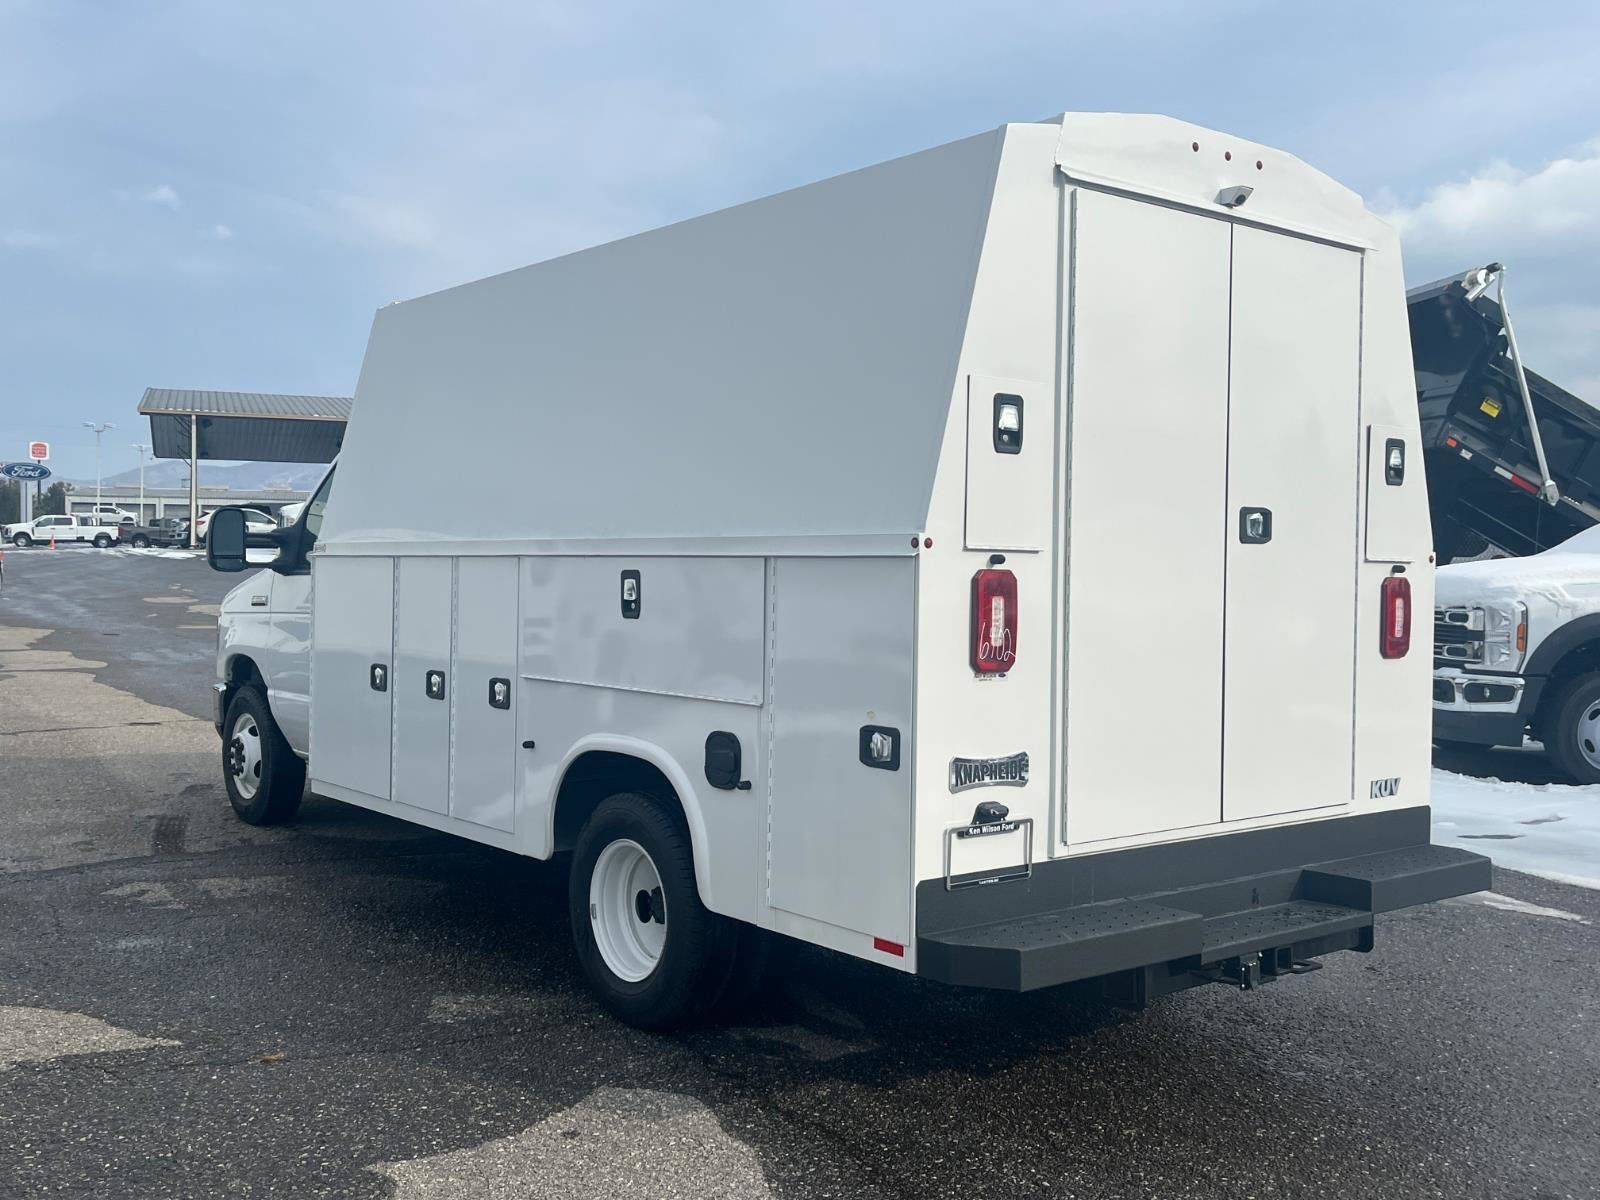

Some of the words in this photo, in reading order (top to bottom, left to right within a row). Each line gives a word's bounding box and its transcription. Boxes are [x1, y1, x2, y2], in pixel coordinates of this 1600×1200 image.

[11, 465, 41, 477] Ford
[954, 757, 1029, 787] KNAPHEIDE
[1370, 777, 1401, 799] KUV
[969, 827, 980, 835] Ken
[982, 825, 1000, 833] Wilson
